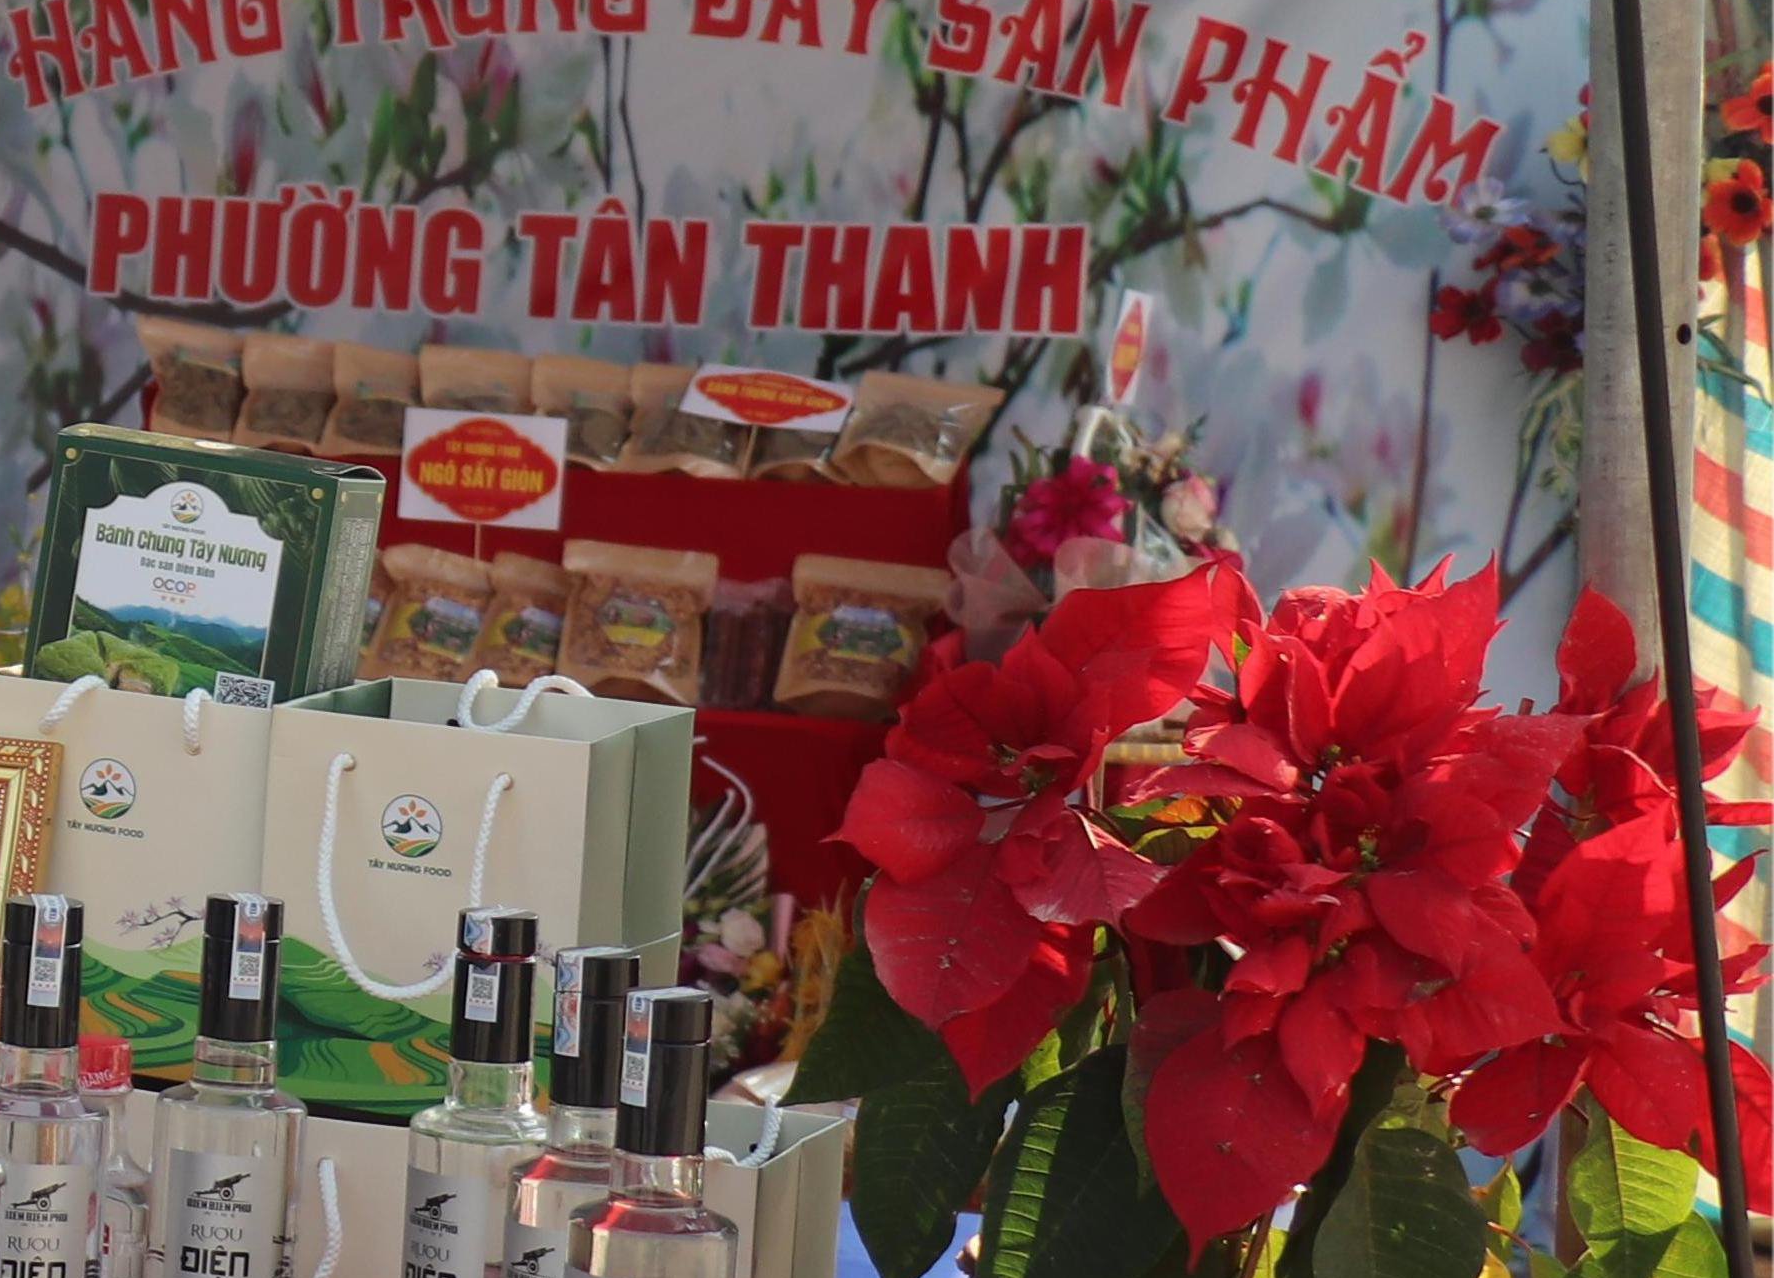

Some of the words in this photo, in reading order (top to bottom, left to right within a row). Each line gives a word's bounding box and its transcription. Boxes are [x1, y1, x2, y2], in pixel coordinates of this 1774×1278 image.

[1161, 14, 1509, 206] PHẨM
[87, 185, 481, 315] PHƯỜNG
[517, 203, 708, 326] TÂN
[744, 221, 1087, 335] THANH
[153, 577, 196, 594] OCOP
[118, 827, 144, 839] FOOD
[423, 866, 452, 878] FOOD
